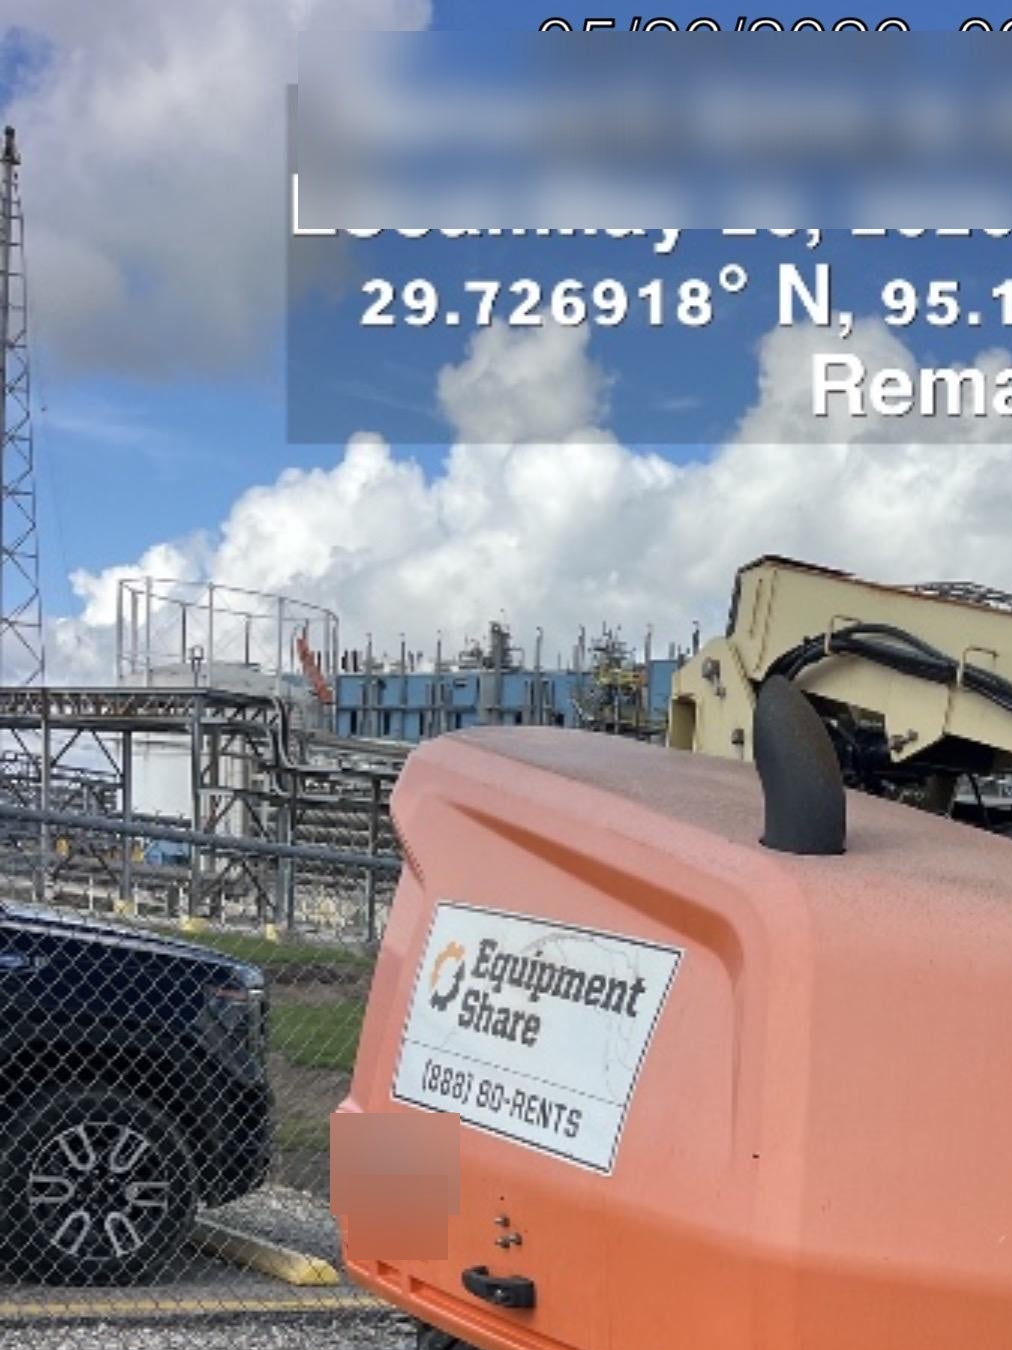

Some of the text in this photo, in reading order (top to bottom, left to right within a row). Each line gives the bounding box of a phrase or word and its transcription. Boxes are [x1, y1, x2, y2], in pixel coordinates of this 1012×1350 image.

[457, 988, 541, 1048] Share
[471, 938, 647, 1018] Equipment
[421, 1058, 583, 1139] (888) 80-RENTS
